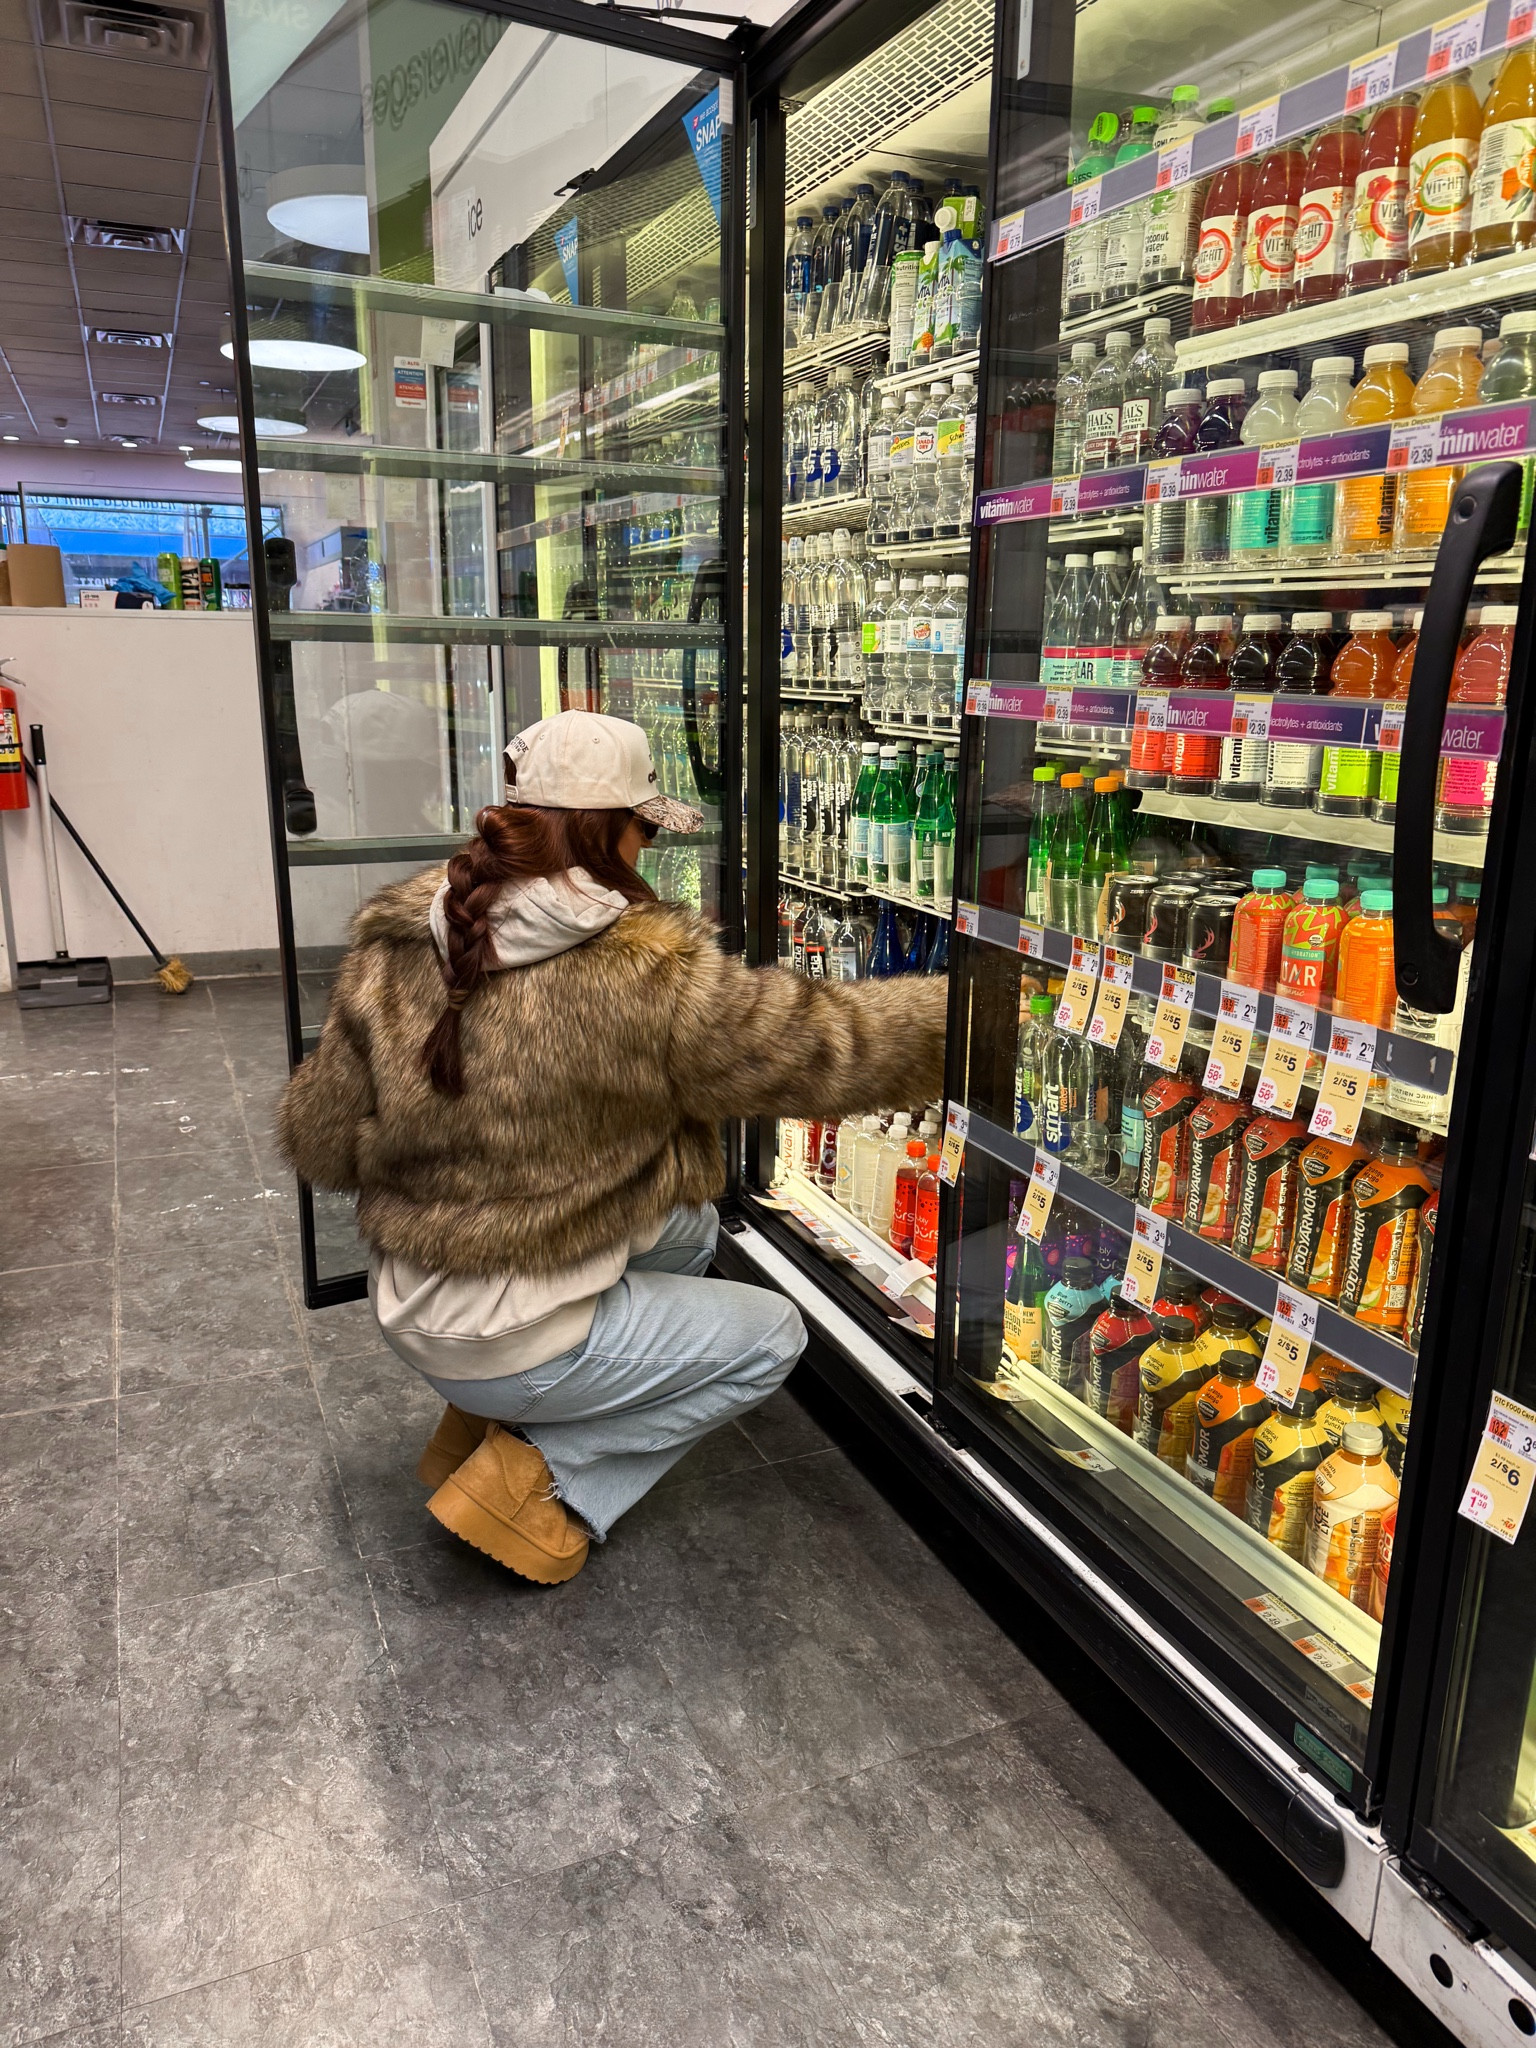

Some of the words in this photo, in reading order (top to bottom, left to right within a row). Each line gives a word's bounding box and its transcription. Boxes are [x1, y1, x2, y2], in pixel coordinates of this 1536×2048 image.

[1452, 42, 1478, 64] $3.09
[1367, 80, 1389, 100] $3.09
[696, 121, 722, 152] SNAP
[1254, 130, 1274, 149] $2.79
[1332, 192, 1344, 204] 35
[467, 197, 484, 240] ice
[1087, 411, 1114, 428] HAL'S
[1393, 420, 1409, 429] Plus
[1411, 414, 1441, 425] Deposit
[822, 419, 834, 474] smart
[915, 438, 934, 446] CANADA
[1275, 439, 1299, 449] Deposit
[1439, 423, 1522, 455] minwater
[807, 422, 821, 475] smart
[1410, 448, 1433, 465] $2.39
[1331, 449, 1370, 466] antioxidants
[1275, 467, 1294, 483] $2.39
[1103, 484, 1130, 497] antioxidants
[1161, 485, 1177, 499] $2.39
[980, 496, 1035, 520] vitaminwater
[1075, 662, 1094, 681] LAR
[1089, 703, 1115, 715] antioxidants
[1167, 706, 1209, 727] inwater
[1395, 704, 1406, 712] FOO
[1150, 714, 1164, 727] $2.39
[1248, 722, 1266, 736] $2.39
[1270, 715, 1299, 729] lectrolytes
[1306, 718, 1343, 732] antioxidants
[1229, 738, 1242, 779] vitami
[1326, 746, 1339, 791] vitami
[1290, 950, 1318, 959] HYDRATION
[1071, 981, 1089, 997] 2/$5
[1104, 993, 1122, 1010] 2/$5
[1162, 1013, 1181, 1031] 2/$5
[1221, 1035, 1242, 1053] 2/$5
[1210, 1062, 1221, 1070] save
[1274, 1052, 1297, 1072] 2/$5
[1023, 1068, 1031, 1095] water
[1206, 1068, 1222, 1081] 58¢
[1257, 1087, 1274, 1101] 58¢
[1261, 1081, 1274, 1090] save
[1332, 1077, 1358, 1097] 2/$5
[1059, 1086, 1068, 1113] water
[1045, 1081, 1060, 1144] smart
[1314, 1113, 1332, 1127] 58¢
[1318, 1107, 1333, 1116] save
[784, 1129, 794, 1168] evian
[1313, 1144, 1333, 1155] Orange
[1139, 1118, 1153, 1198] BODYARMOR
[1187, 1138, 1204, 1222] BODYARMOR
[1367, 1166, 1384, 1179] Orange
[1032, 1192, 1046, 1209] 2/$5
[1237, 1162, 1258, 1246] BODYARMOR
[1293, 1186, 1317, 1276] BODYARMOR
[1136, 1253, 1154, 1273] 2/$5
[1342, 1209, 1366, 1303] BODYARMOR
[1277, 1338, 1300, 1362] 2/$5
[1146, 1360, 1161, 1372] Punch
[1263, 1364, 1276, 1375] save
[1206, 1387, 1224, 1400] Orange
[1494, 1395, 1506, 1406] OTC
[1505, 1401, 1522, 1414] FOOD
[1521, 1408, 1535, 1422] Card
[1323, 1420, 1342, 1431] Punch
[1522, 1436, 1536, 1453] 36
[1316, 1474, 1326, 1487] LOW
[1489, 1458, 1521, 1487] 2/$6
[1470, 1487, 1489, 1501] save
[1322, 1510, 1331, 1536] LYTE
[1263, 1611, 1280, 1626] $2.49
[1313, 1653, 1332, 1669] $2.49
